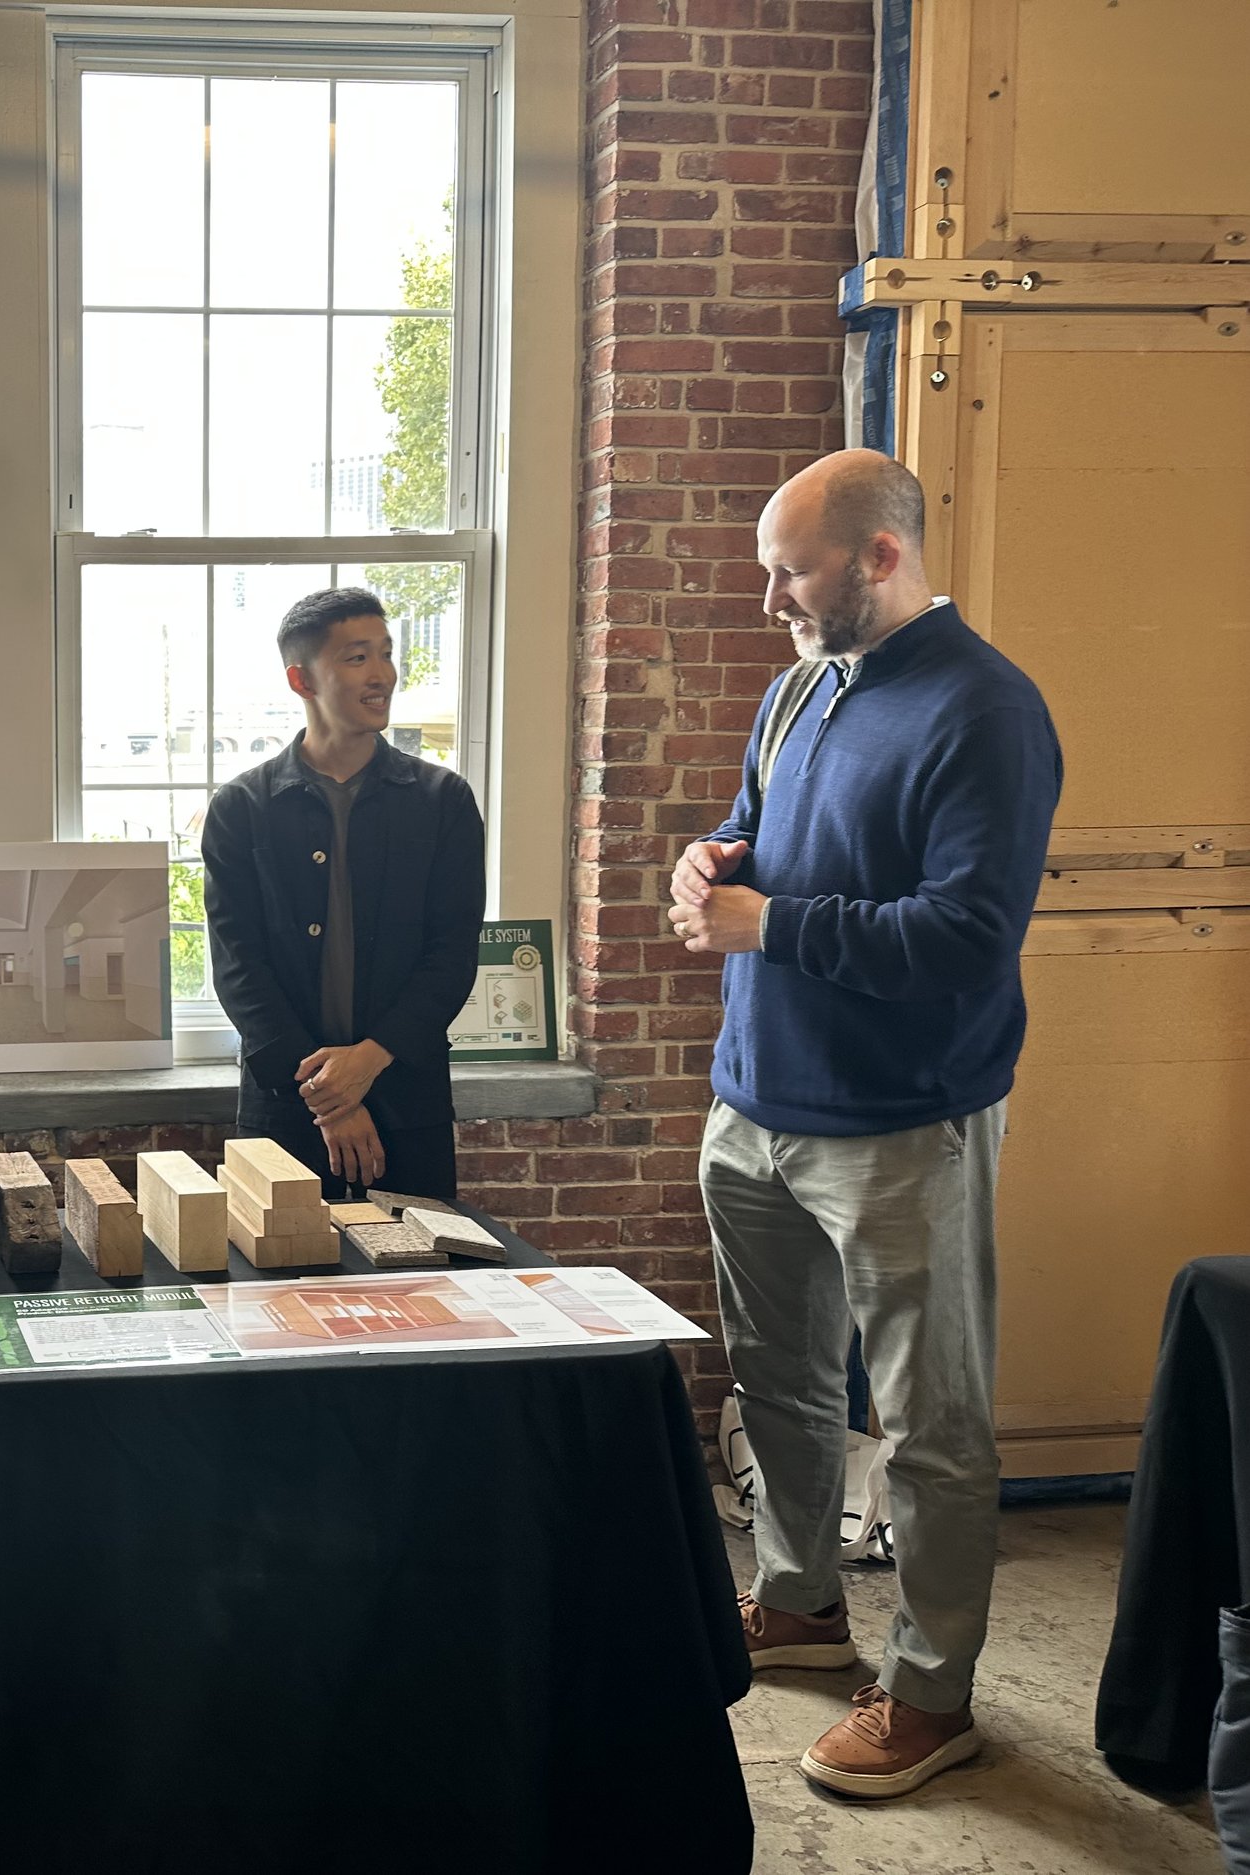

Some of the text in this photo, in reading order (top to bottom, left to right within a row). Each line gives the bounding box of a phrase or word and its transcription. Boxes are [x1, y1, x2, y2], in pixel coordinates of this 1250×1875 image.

[495, 928, 531, 943] SYSTEM
[13, 1298, 72, 1309] PASSIVE
[73, 1294, 139, 1306] RETROFIT
